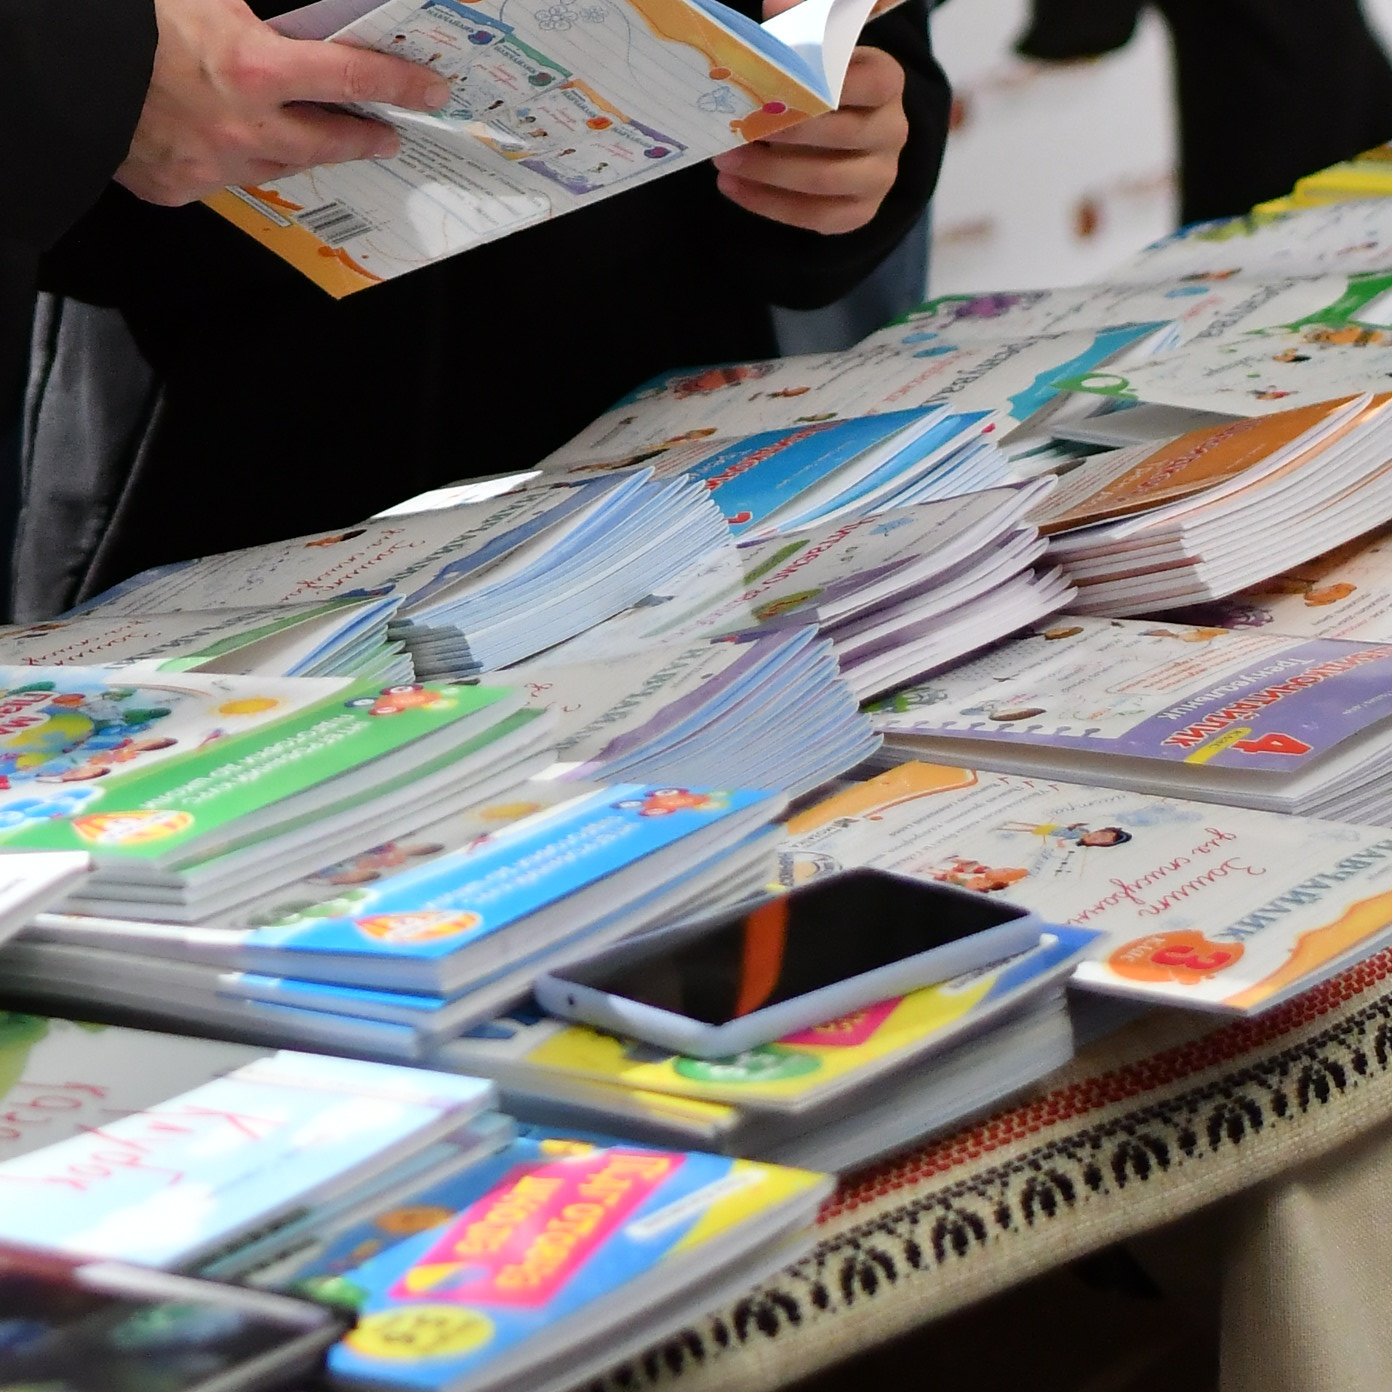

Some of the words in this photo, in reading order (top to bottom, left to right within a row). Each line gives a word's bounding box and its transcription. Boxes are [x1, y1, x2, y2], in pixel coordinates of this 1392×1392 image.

[1158, 654, 1315, 722] Тренувальник
[1228, 730, 1314, 757] 4
[1063, 855, 1192, 927] списуванн
[1136, 855, 1267, 919] Зошит
[1150, 944, 1232, 971] 3
